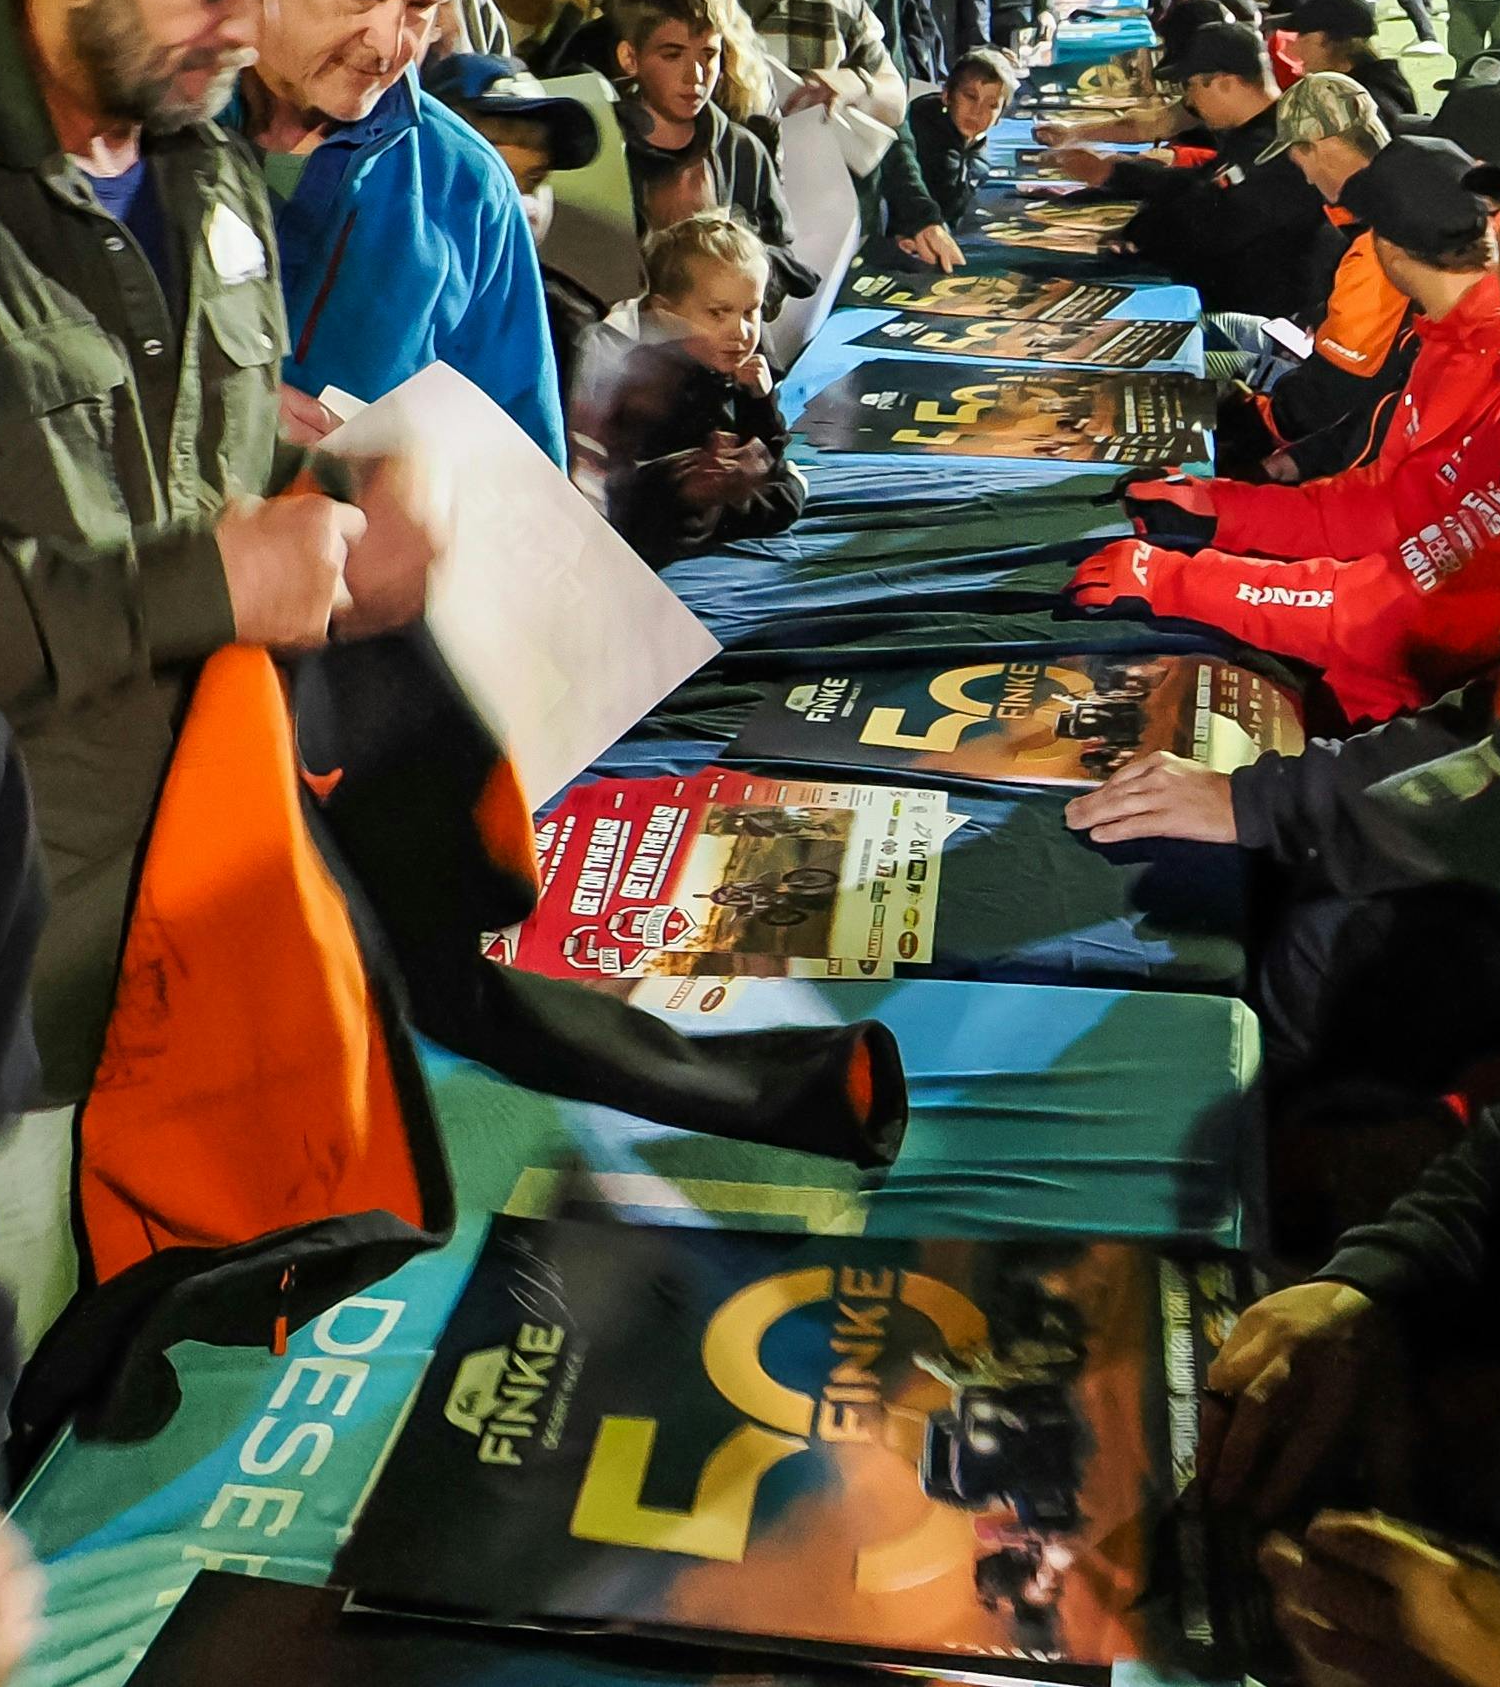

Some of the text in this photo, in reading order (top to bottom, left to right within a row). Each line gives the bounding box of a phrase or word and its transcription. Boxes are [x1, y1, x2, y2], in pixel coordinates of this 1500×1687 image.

[1399, 535, 1438, 593] froth
[805, 676, 850, 723] FINKE
[997, 663, 1039, 720] FINKE
[817, 1266, 893, 1442] FINKE
[478, 1322, 567, 1467] FINKE
